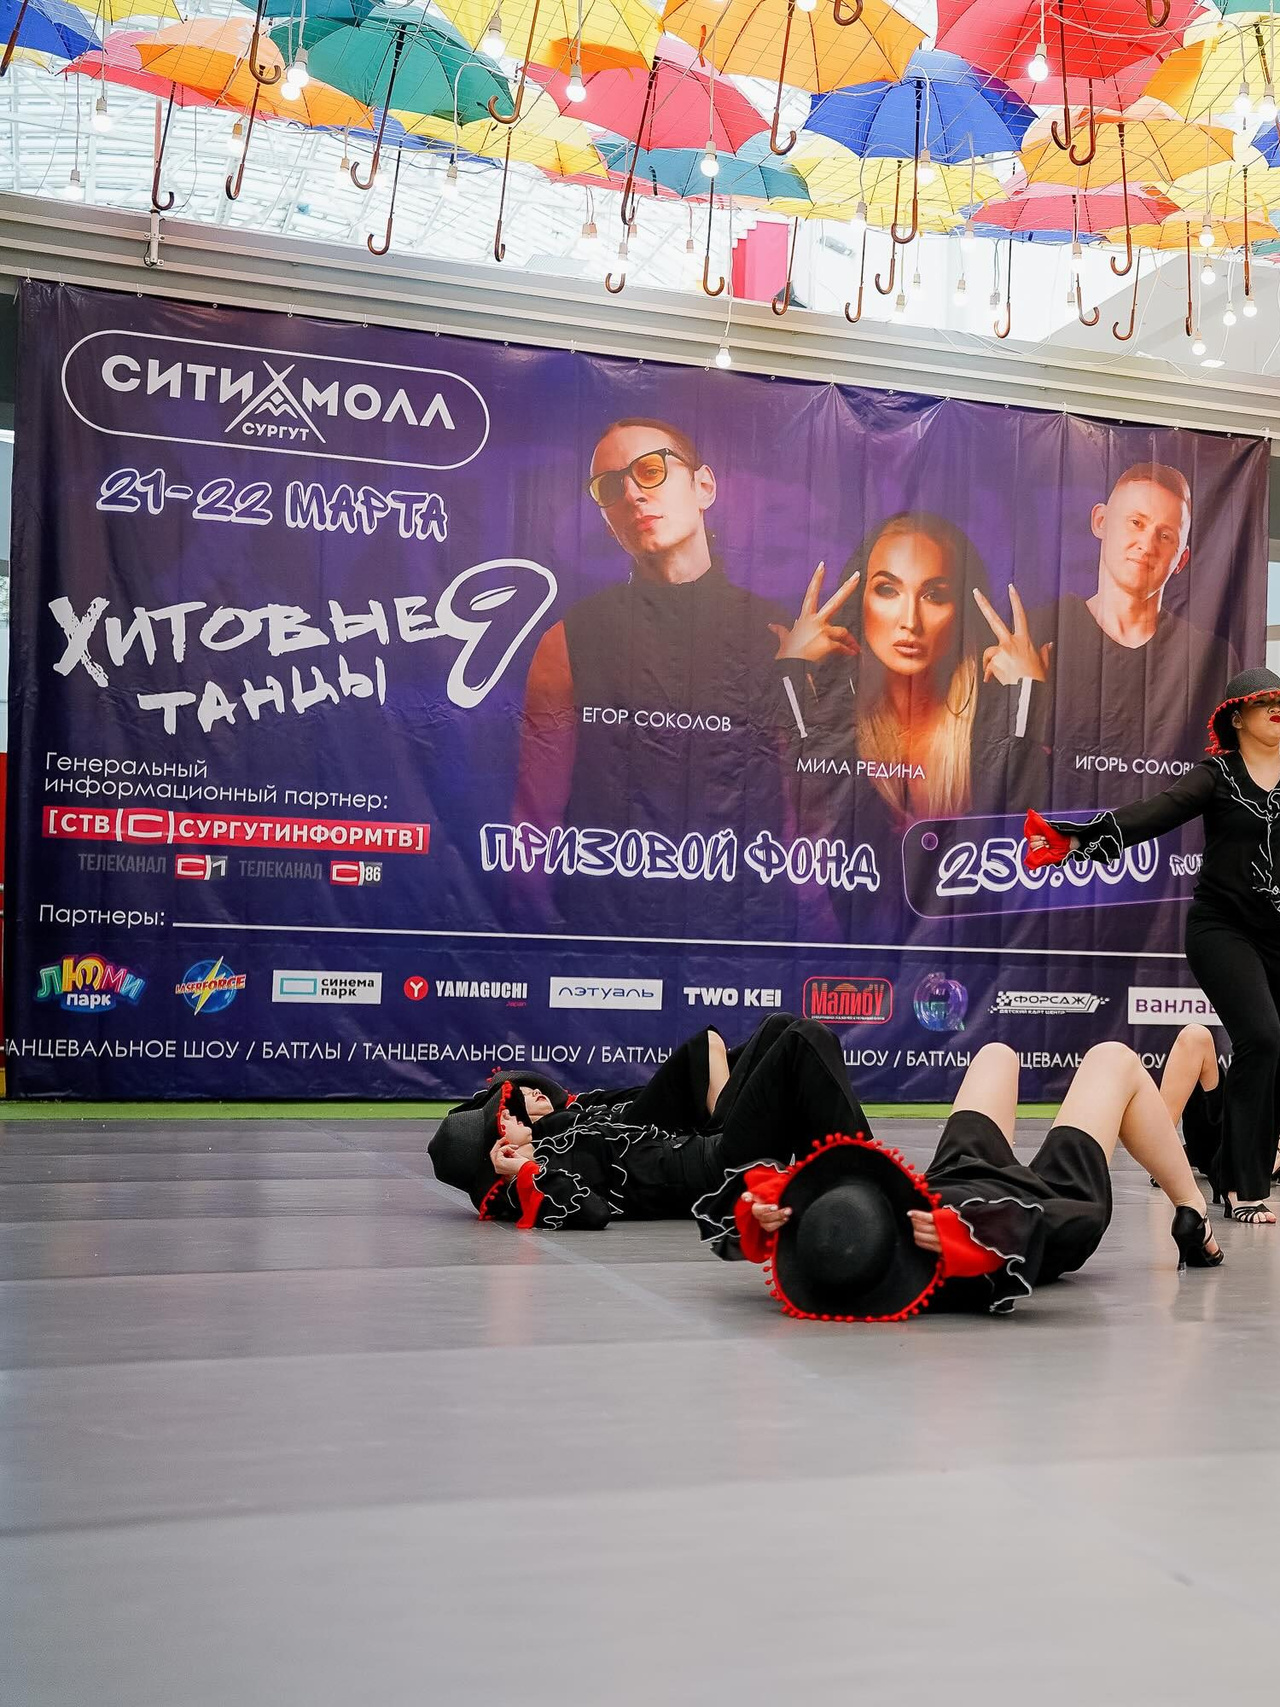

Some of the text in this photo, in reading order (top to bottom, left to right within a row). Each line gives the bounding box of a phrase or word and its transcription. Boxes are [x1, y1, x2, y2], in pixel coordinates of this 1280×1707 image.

[241, 421, 310, 442] СУРГУТ
[96, 468, 448, 542] 21-22 МАРТА
[138, 656, 387, 735] ТАНЦЫ
[582, 706, 732, 732] ЕГОР СОКОЛОВ
[46, 751, 208, 779] Генеральный
[796, 757, 926, 779] МИЛА РЕДИНА
[1075, 754, 1194, 776] ИГОРЬ СОЛОВ
[44, 775, 388, 813] информационный партнер:
[78, 852, 167, 875] ТЕЛЕКАНАЛ
[480, 822, 881, 892] ПРИЗОВОЙ ФОНД
[238, 860, 323, 881] ТЕЛЕКАНАЛ
[39, 903, 166, 929] Партнеры:
[320, 977, 375, 988] синема
[320, 986, 357, 998] парк
[435, 980, 529, 999] YAMAGUCHI
[66, 992, 111, 1009] парк
[683, 986, 782, 1007] TWO KEI
[1013, 995, 1087, 1006] ФОРСАЖ
[183, 1040, 240, 1060] ШОУ
[262, 1041, 341, 1060] БАТТЛЫ
[363, 1042, 526, 1063] ТАНЦЕВАЛЬНОЕ
[531, 1045, 582, 1063] ШОУ
[601, 1045, 673, 1064] БАТТЛЫ
[843, 1049, 889, 1066] ШОУ
[906, 1050, 971, 1067] БАТТЛЫ
